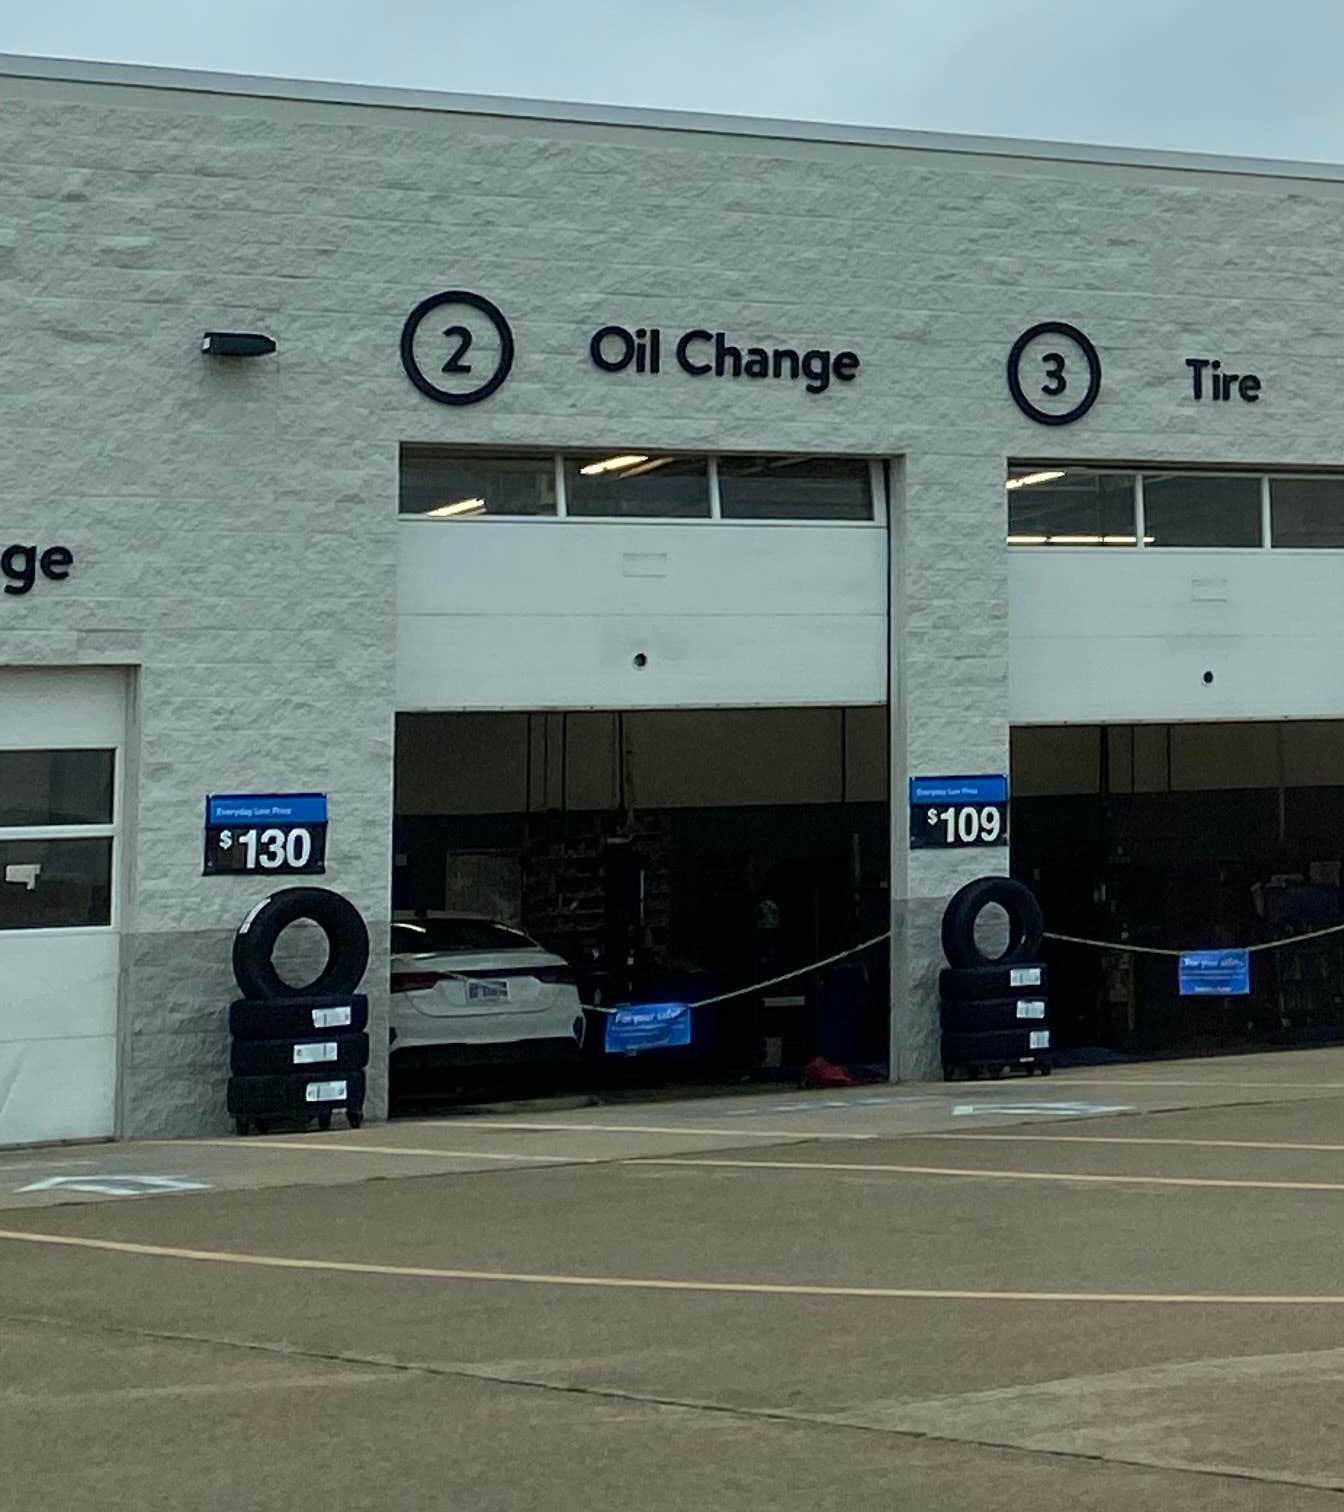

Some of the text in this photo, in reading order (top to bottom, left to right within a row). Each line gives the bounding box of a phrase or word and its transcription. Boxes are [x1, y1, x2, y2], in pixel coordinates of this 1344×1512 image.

[441, 325, 473, 375] 2
[589, 325, 860, 395] Oil Change
[1041, 352, 1067, 397] 3
[1185, 358, 1262, 403] Tire
